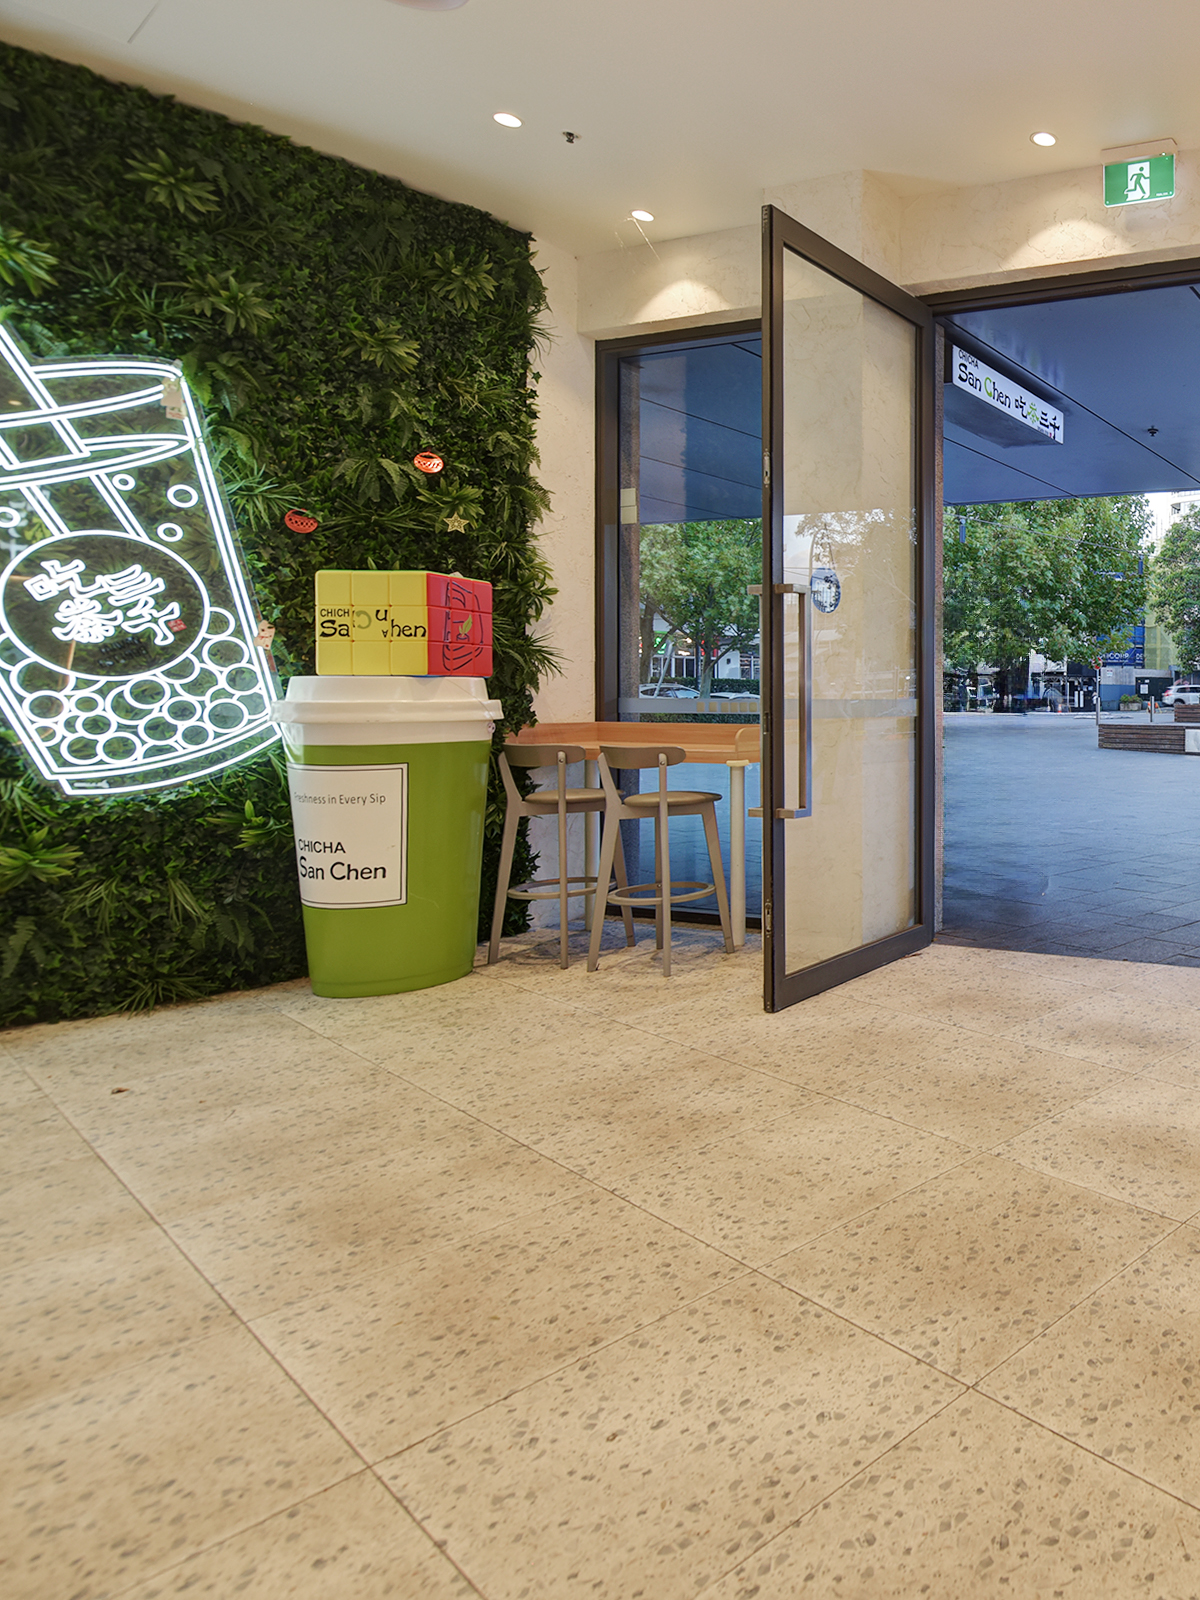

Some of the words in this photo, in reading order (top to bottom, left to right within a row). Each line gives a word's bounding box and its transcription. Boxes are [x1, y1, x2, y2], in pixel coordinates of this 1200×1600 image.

[958, 362, 982, 391] San
[984, 376, 1011, 408] Chen
[1014, 395, 1060, 439] 吃茶三千
[328, 794, 336, 804] in
[339, 794, 367, 805] Every
[369, 793, 386, 804] Sip
[298, 838, 345, 853] CHICHA
[299, 855, 324, 880] San
[329, 861, 386, 880] Chen
